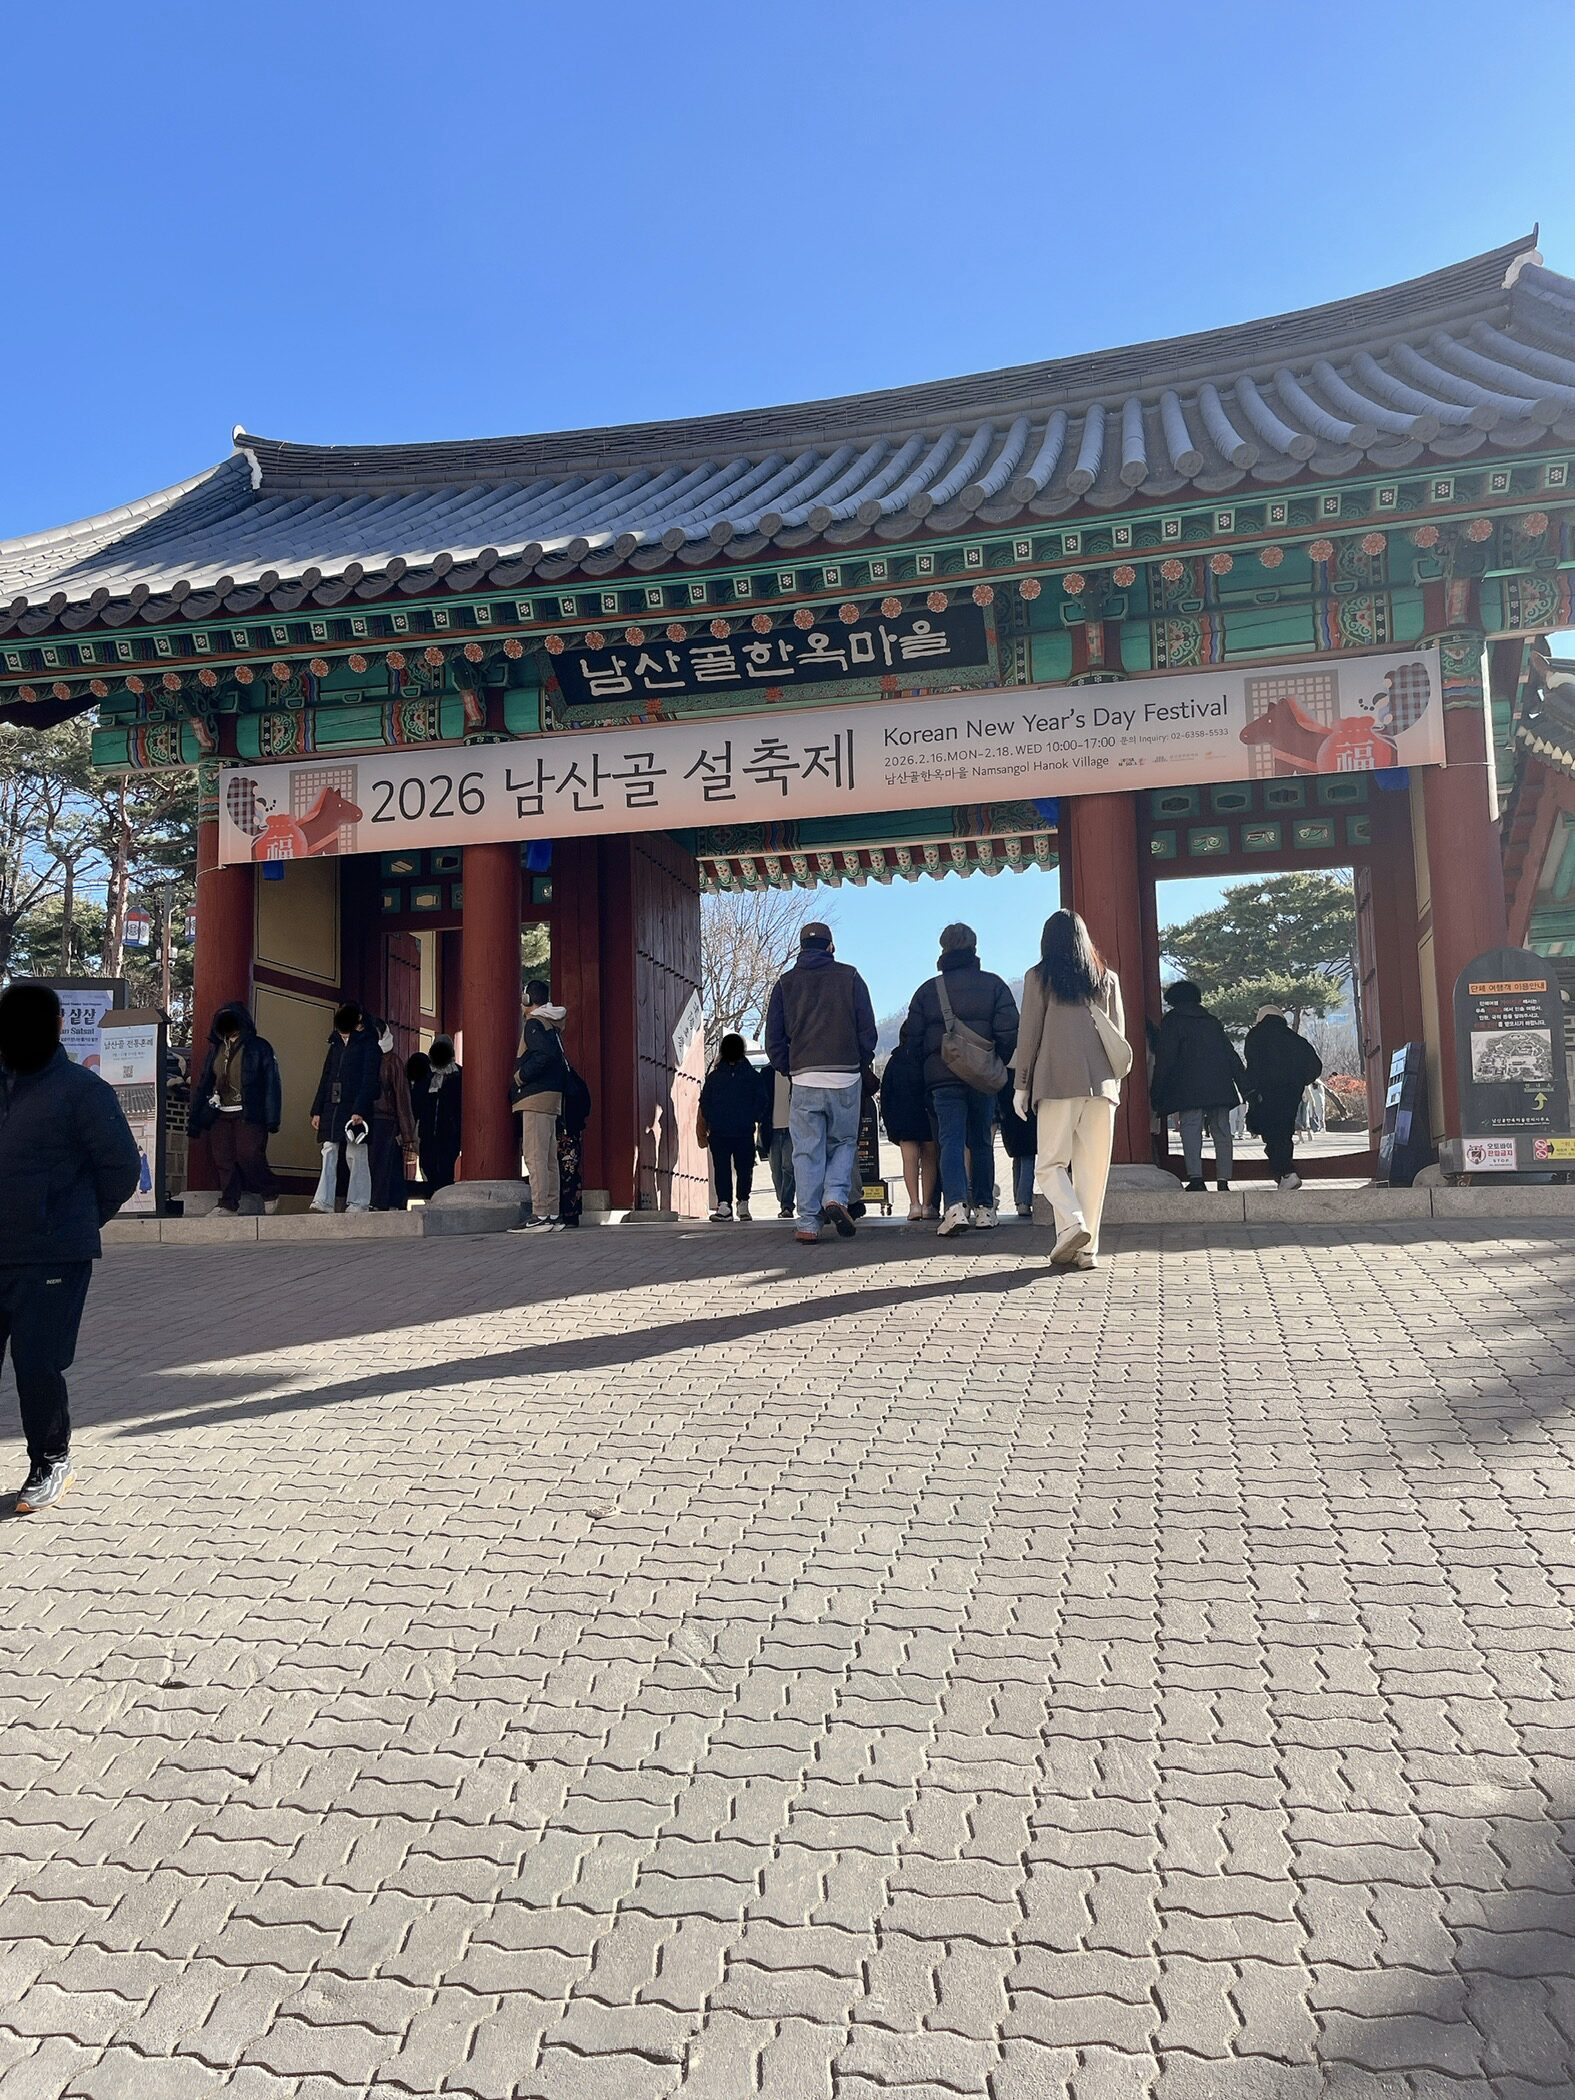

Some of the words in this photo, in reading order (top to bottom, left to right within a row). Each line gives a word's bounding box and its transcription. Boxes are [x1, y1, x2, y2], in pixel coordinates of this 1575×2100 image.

[580, 620, 951, 697] 남산골한옥마을
[884, 727, 958, 747] Korean
[966, 719, 1015, 738] New
[1022, 708, 1086, 733] Year's
[1093, 708, 1136, 731] Day
[1144, 695, 1228, 722] Festival
[1045, 736, 1116, 753] 10:00-17:00
[1120, 735, 1137, 746] 문의
[1139, 732, 1169, 745] Inquiry:
[1171, 728, 1229, 741] 02-6358-5533
[369, 772, 486, 824] 2026
[504, 751, 667, 819] 남산골
[683, 728, 856, 802] 설축제
[885, 766, 969, 786] 남산골한옥마을
[972, 760, 1030, 777] Namsangol
[1033, 758, 1069, 772] Hanok
[1072, 754, 1109, 770] Village
[1470, 985, 1486, 993] 단체
[1488, 983, 1512, 992] 여행객
[1514, 982, 1545, 991] 이용안내
[70, 1027, 95, 1035] Satsat
[1487, 1142, 1513, 1150] 오토바이
